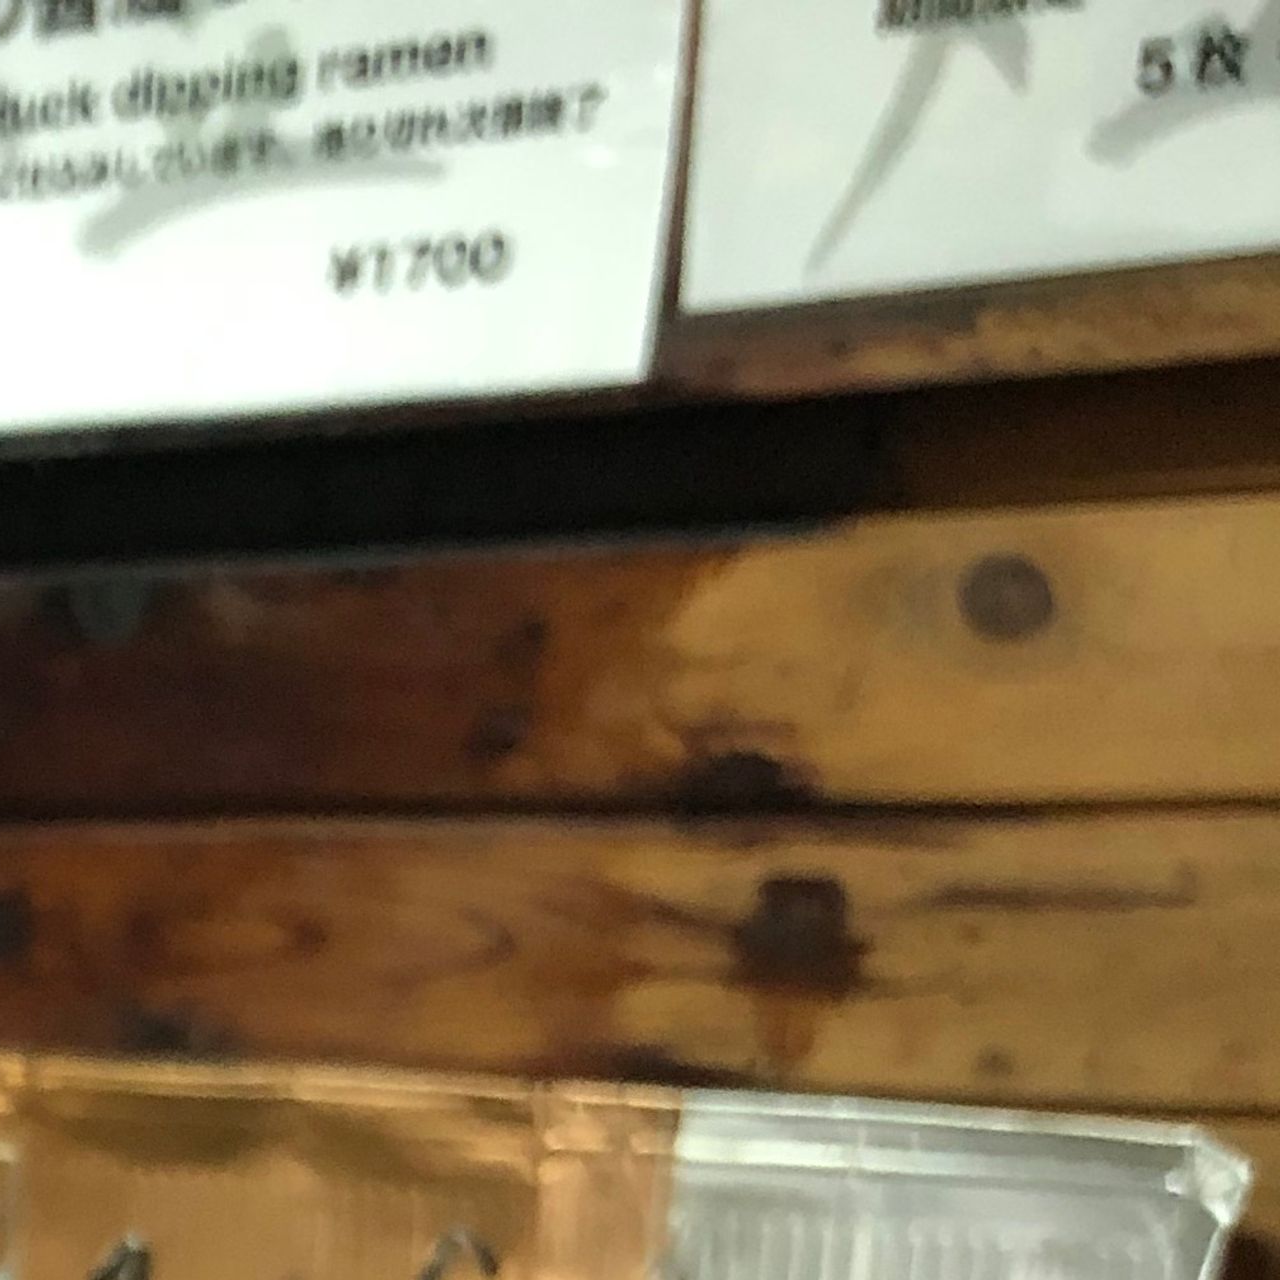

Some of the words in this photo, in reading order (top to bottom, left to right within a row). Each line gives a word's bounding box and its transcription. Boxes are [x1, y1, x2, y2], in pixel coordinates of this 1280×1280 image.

[111, 52, 301, 121] dipping
[316, 32, 495, 93] ramen
[327, 230, 515, 294] ¥1700
